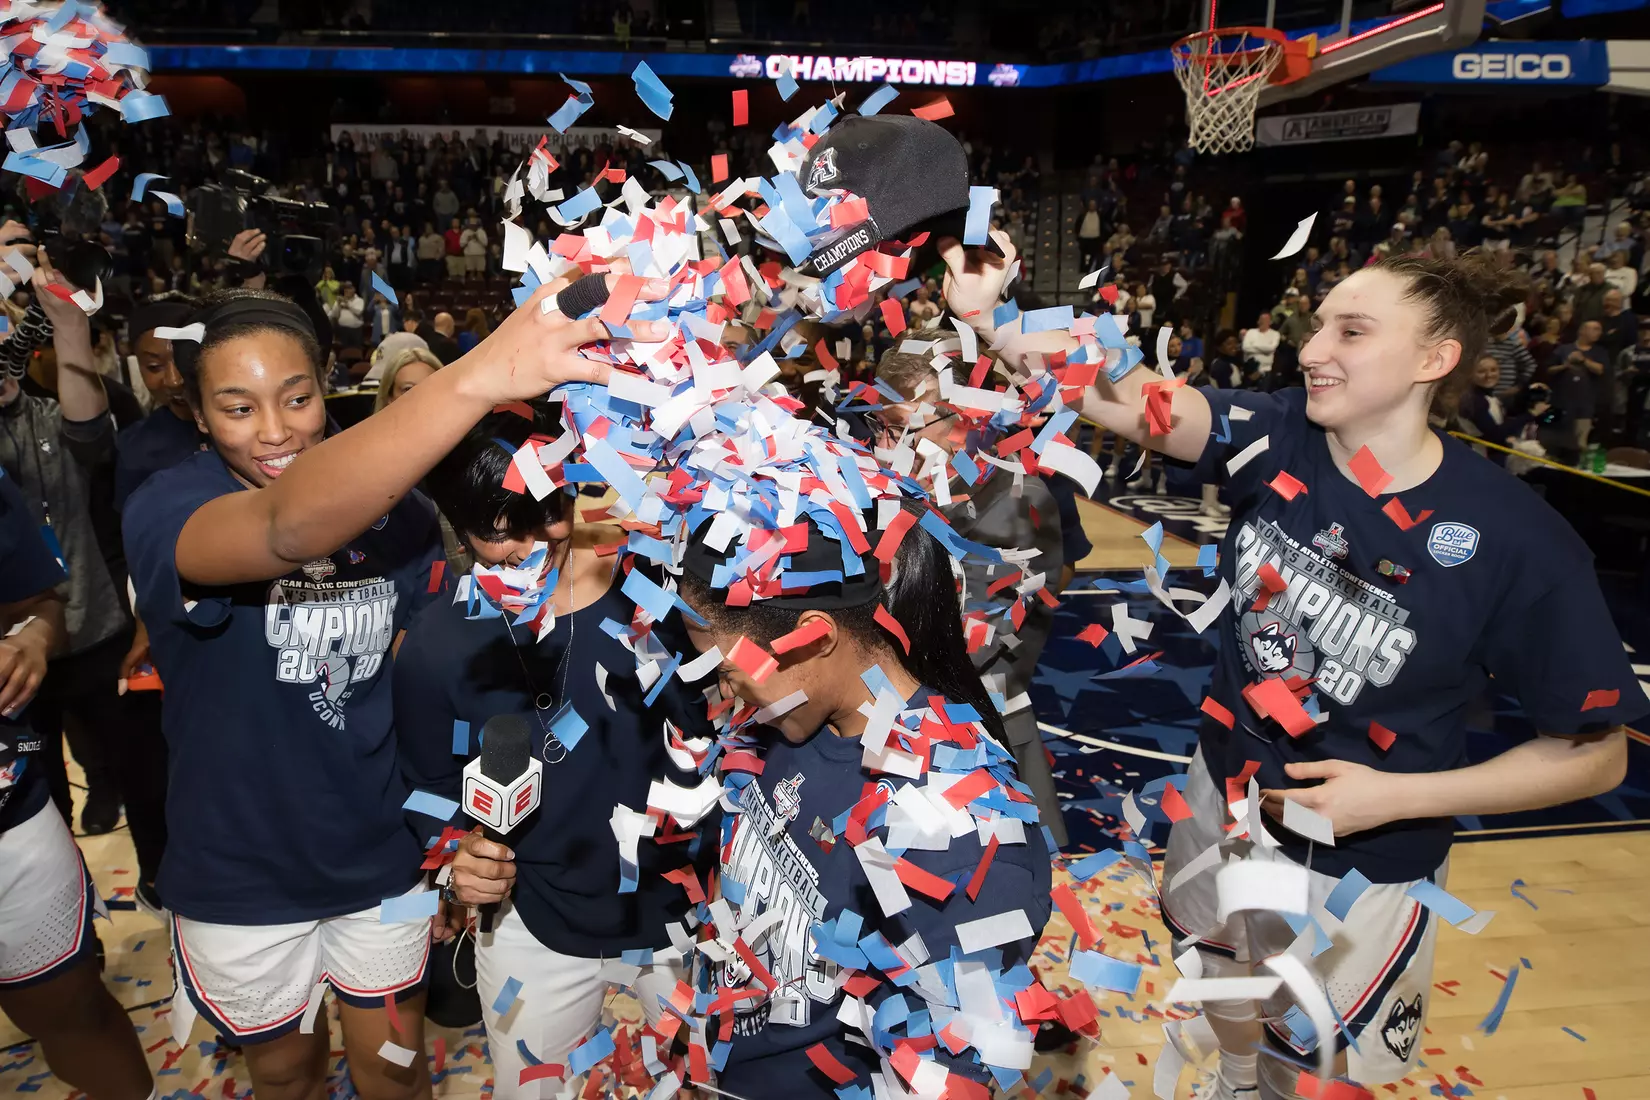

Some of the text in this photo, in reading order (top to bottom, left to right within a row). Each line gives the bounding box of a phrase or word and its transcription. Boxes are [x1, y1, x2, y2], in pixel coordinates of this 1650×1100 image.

[765, 54, 977, 86] CHAMPIONS!
[1453, 53, 1571, 79] GEICO
[813, 229, 870, 272] CHAMPIONS
[1271, 520, 1300, 549] ARICAN
[1300, 546, 1338, 572] ATHLETIC
[1433, 543, 1468, 556] OFFICIAL
[1436, 526, 1474, 542] Blue
[279, 579, 302, 588] ICAN
[304, 581, 334, 590] ATHLETIC
[1258, 520, 1300, 563] WOMEN'S
[1304, 561, 1400, 621] BASKETBALL
[314, 584, 392, 603] BASKETBALL
[1235, 521, 1417, 688] CHAMPIONS
[265, 582, 399, 660] CMPIONS
[351, 651, 385, 684] 20
[1315, 656, 1366, 706] 20
[763, 822, 820, 913] BASKETBALL
[734, 1006, 768, 1037] SKIES
